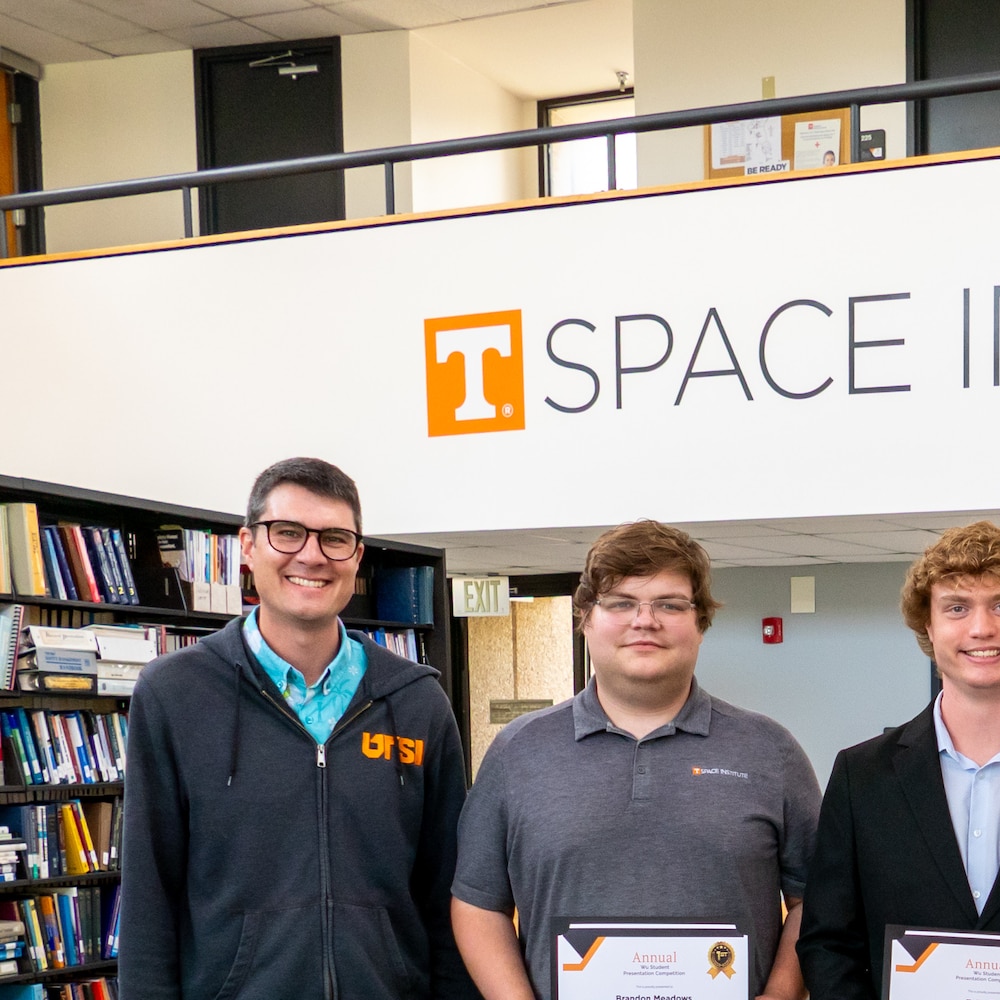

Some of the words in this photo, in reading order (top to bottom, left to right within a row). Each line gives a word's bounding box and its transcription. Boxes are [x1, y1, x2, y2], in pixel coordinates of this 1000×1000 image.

[747, 167, 758, 175] BE
[759, 163, 787, 173] READY
[544, 291, 911, 414] SPACE
[463, 580, 501, 613] EXIT
[720, 769, 749, 779] INSTITUTE
[632, 951, 677, 963] Annual
